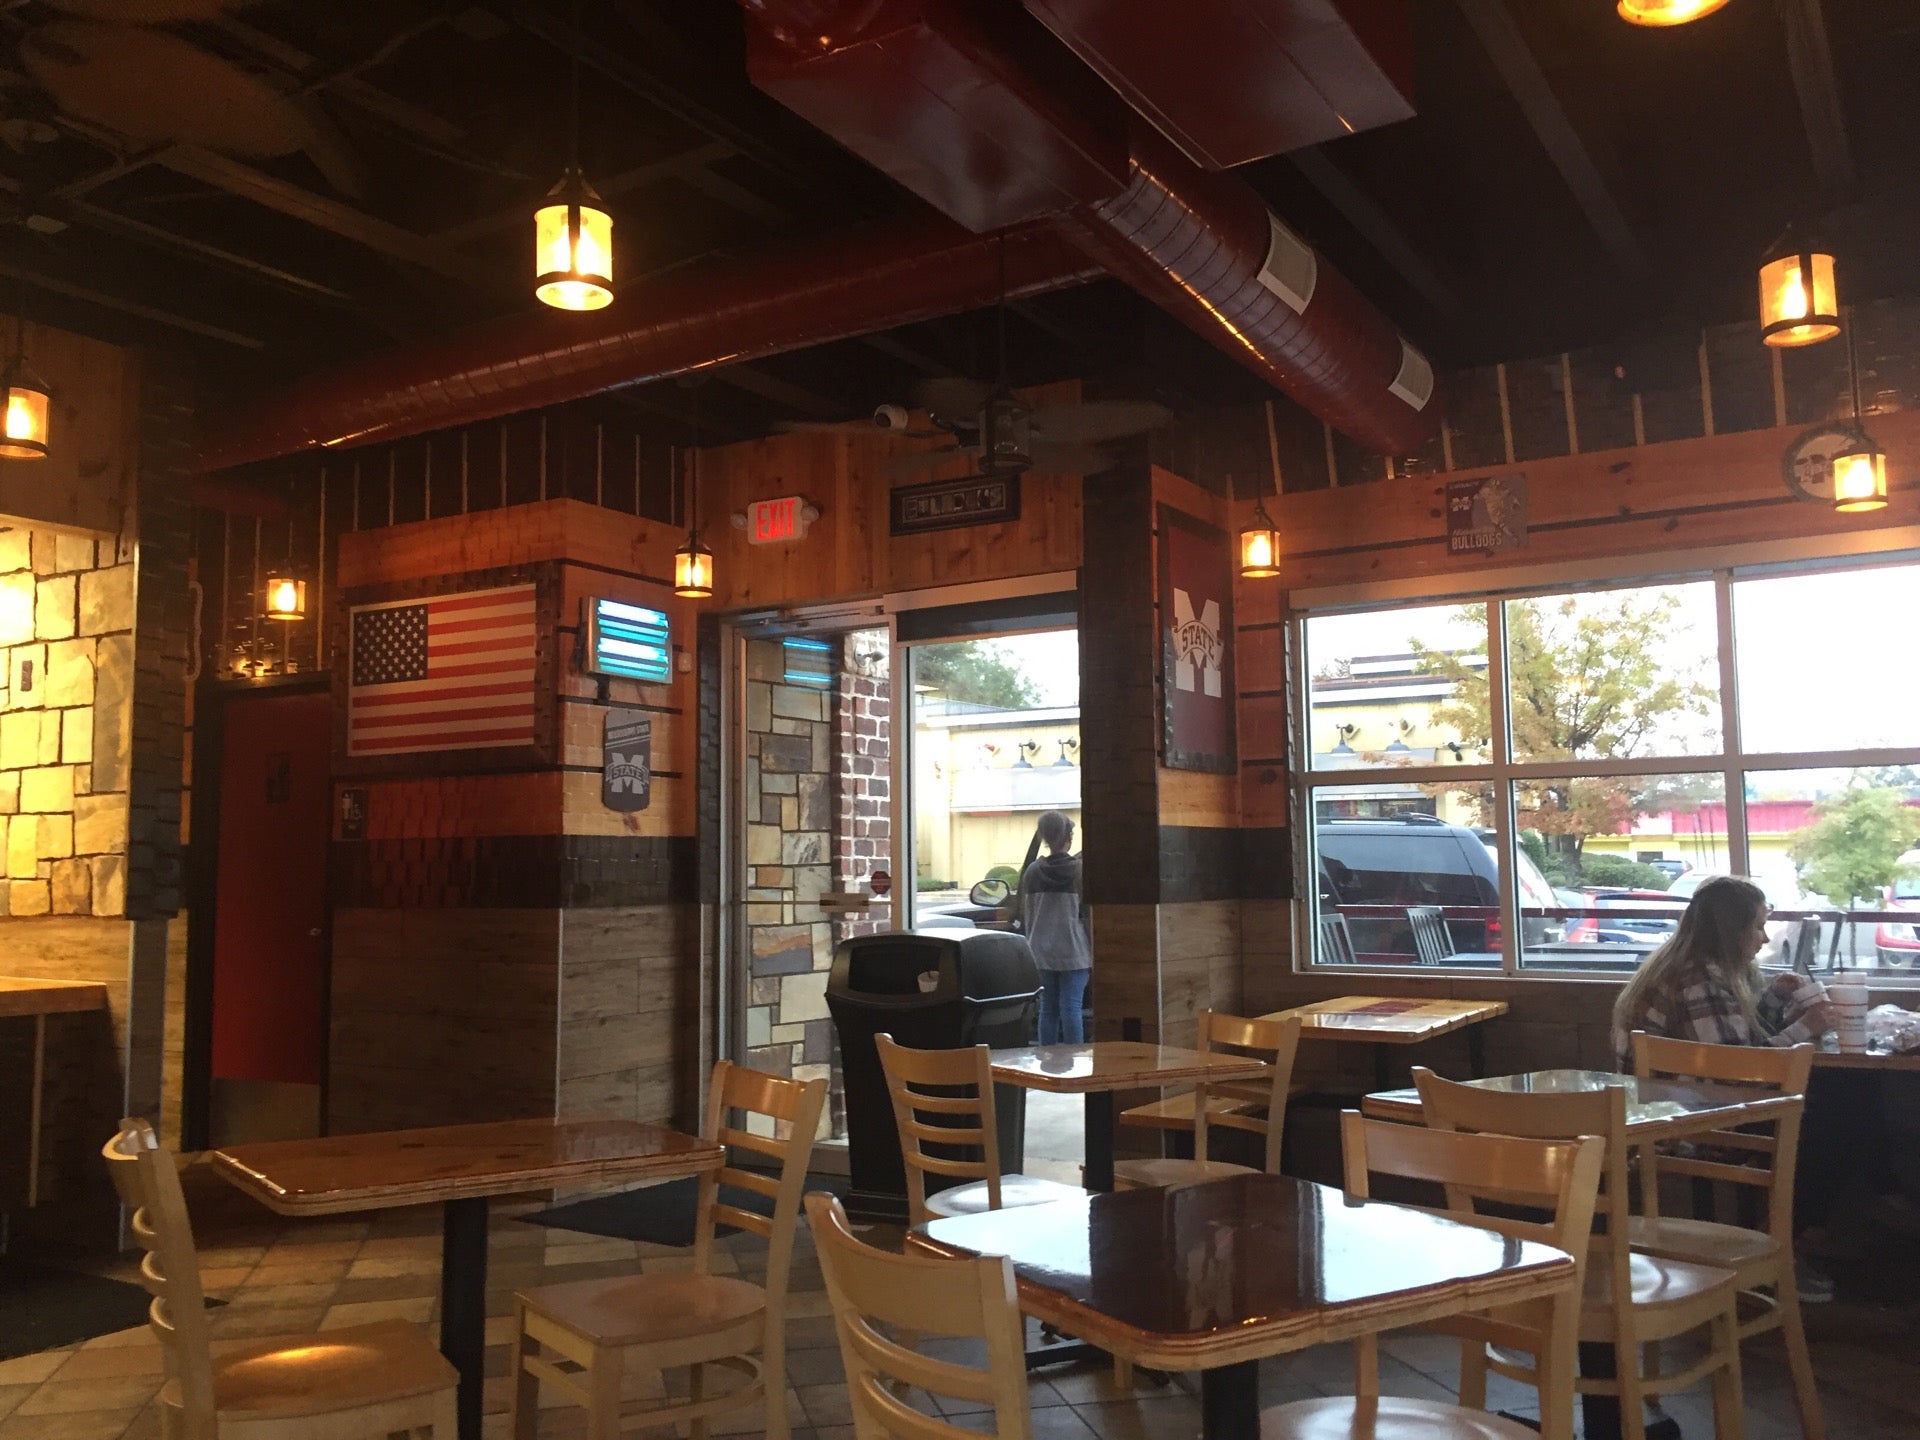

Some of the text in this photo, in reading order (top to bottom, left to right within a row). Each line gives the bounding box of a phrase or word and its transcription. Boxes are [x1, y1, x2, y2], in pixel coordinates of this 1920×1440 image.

[756, 500, 794, 540] EXIT
[1451, 533, 1502, 550] BULLDOGS
[1182, 625, 1215, 661] STATE
[613, 765, 641, 778] STATE
